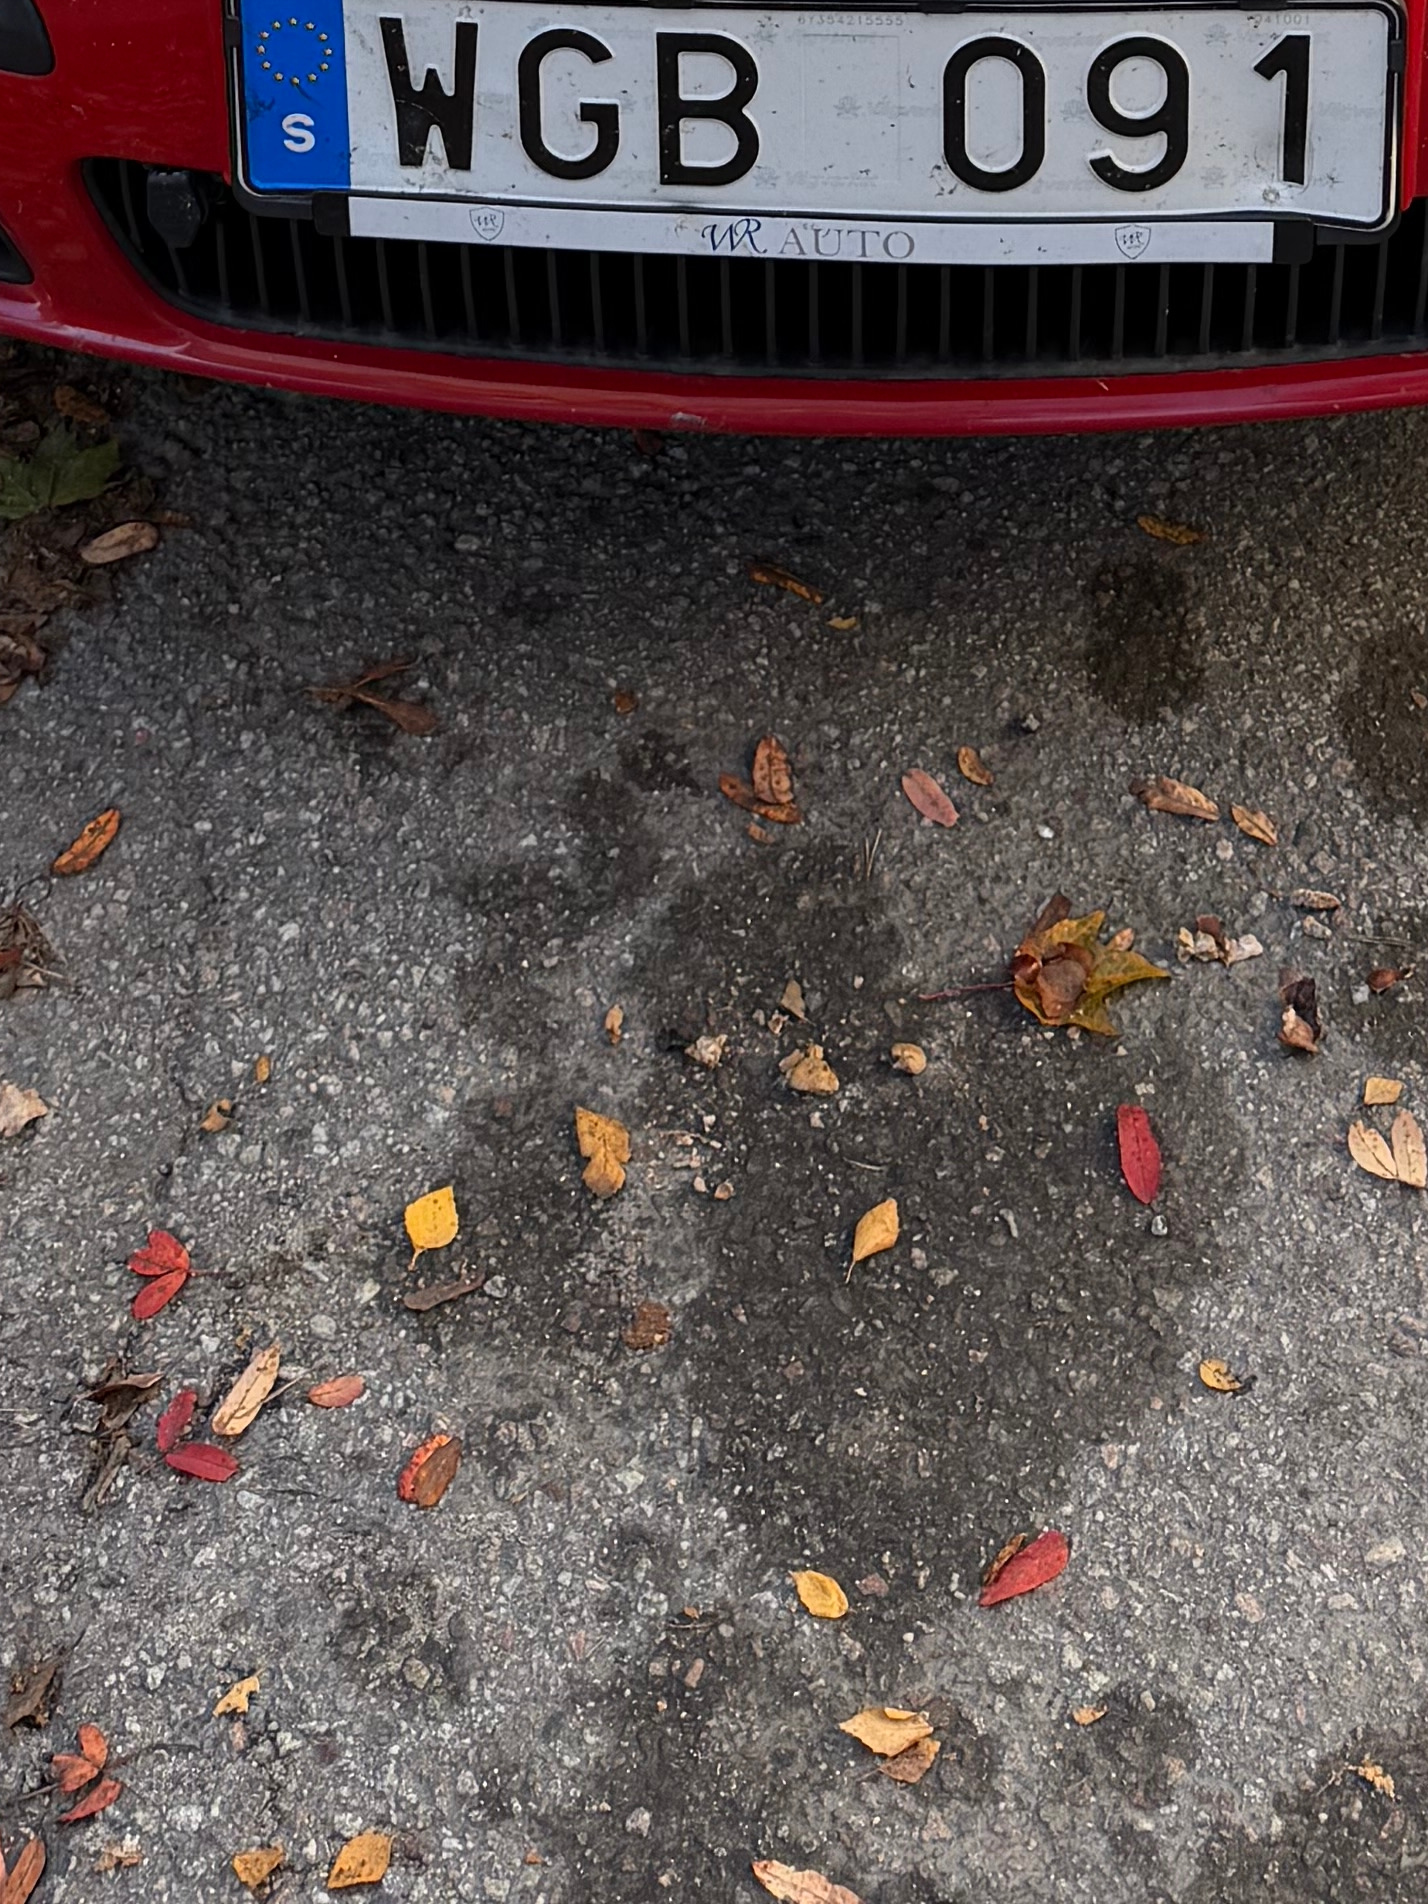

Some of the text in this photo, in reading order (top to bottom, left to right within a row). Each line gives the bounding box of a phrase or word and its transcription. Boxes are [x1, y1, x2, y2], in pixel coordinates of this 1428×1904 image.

[379, 16, 1312, 193] WGB 091
[281, 113, 316, 153] S
[778, 227, 916, 260] AUTO
